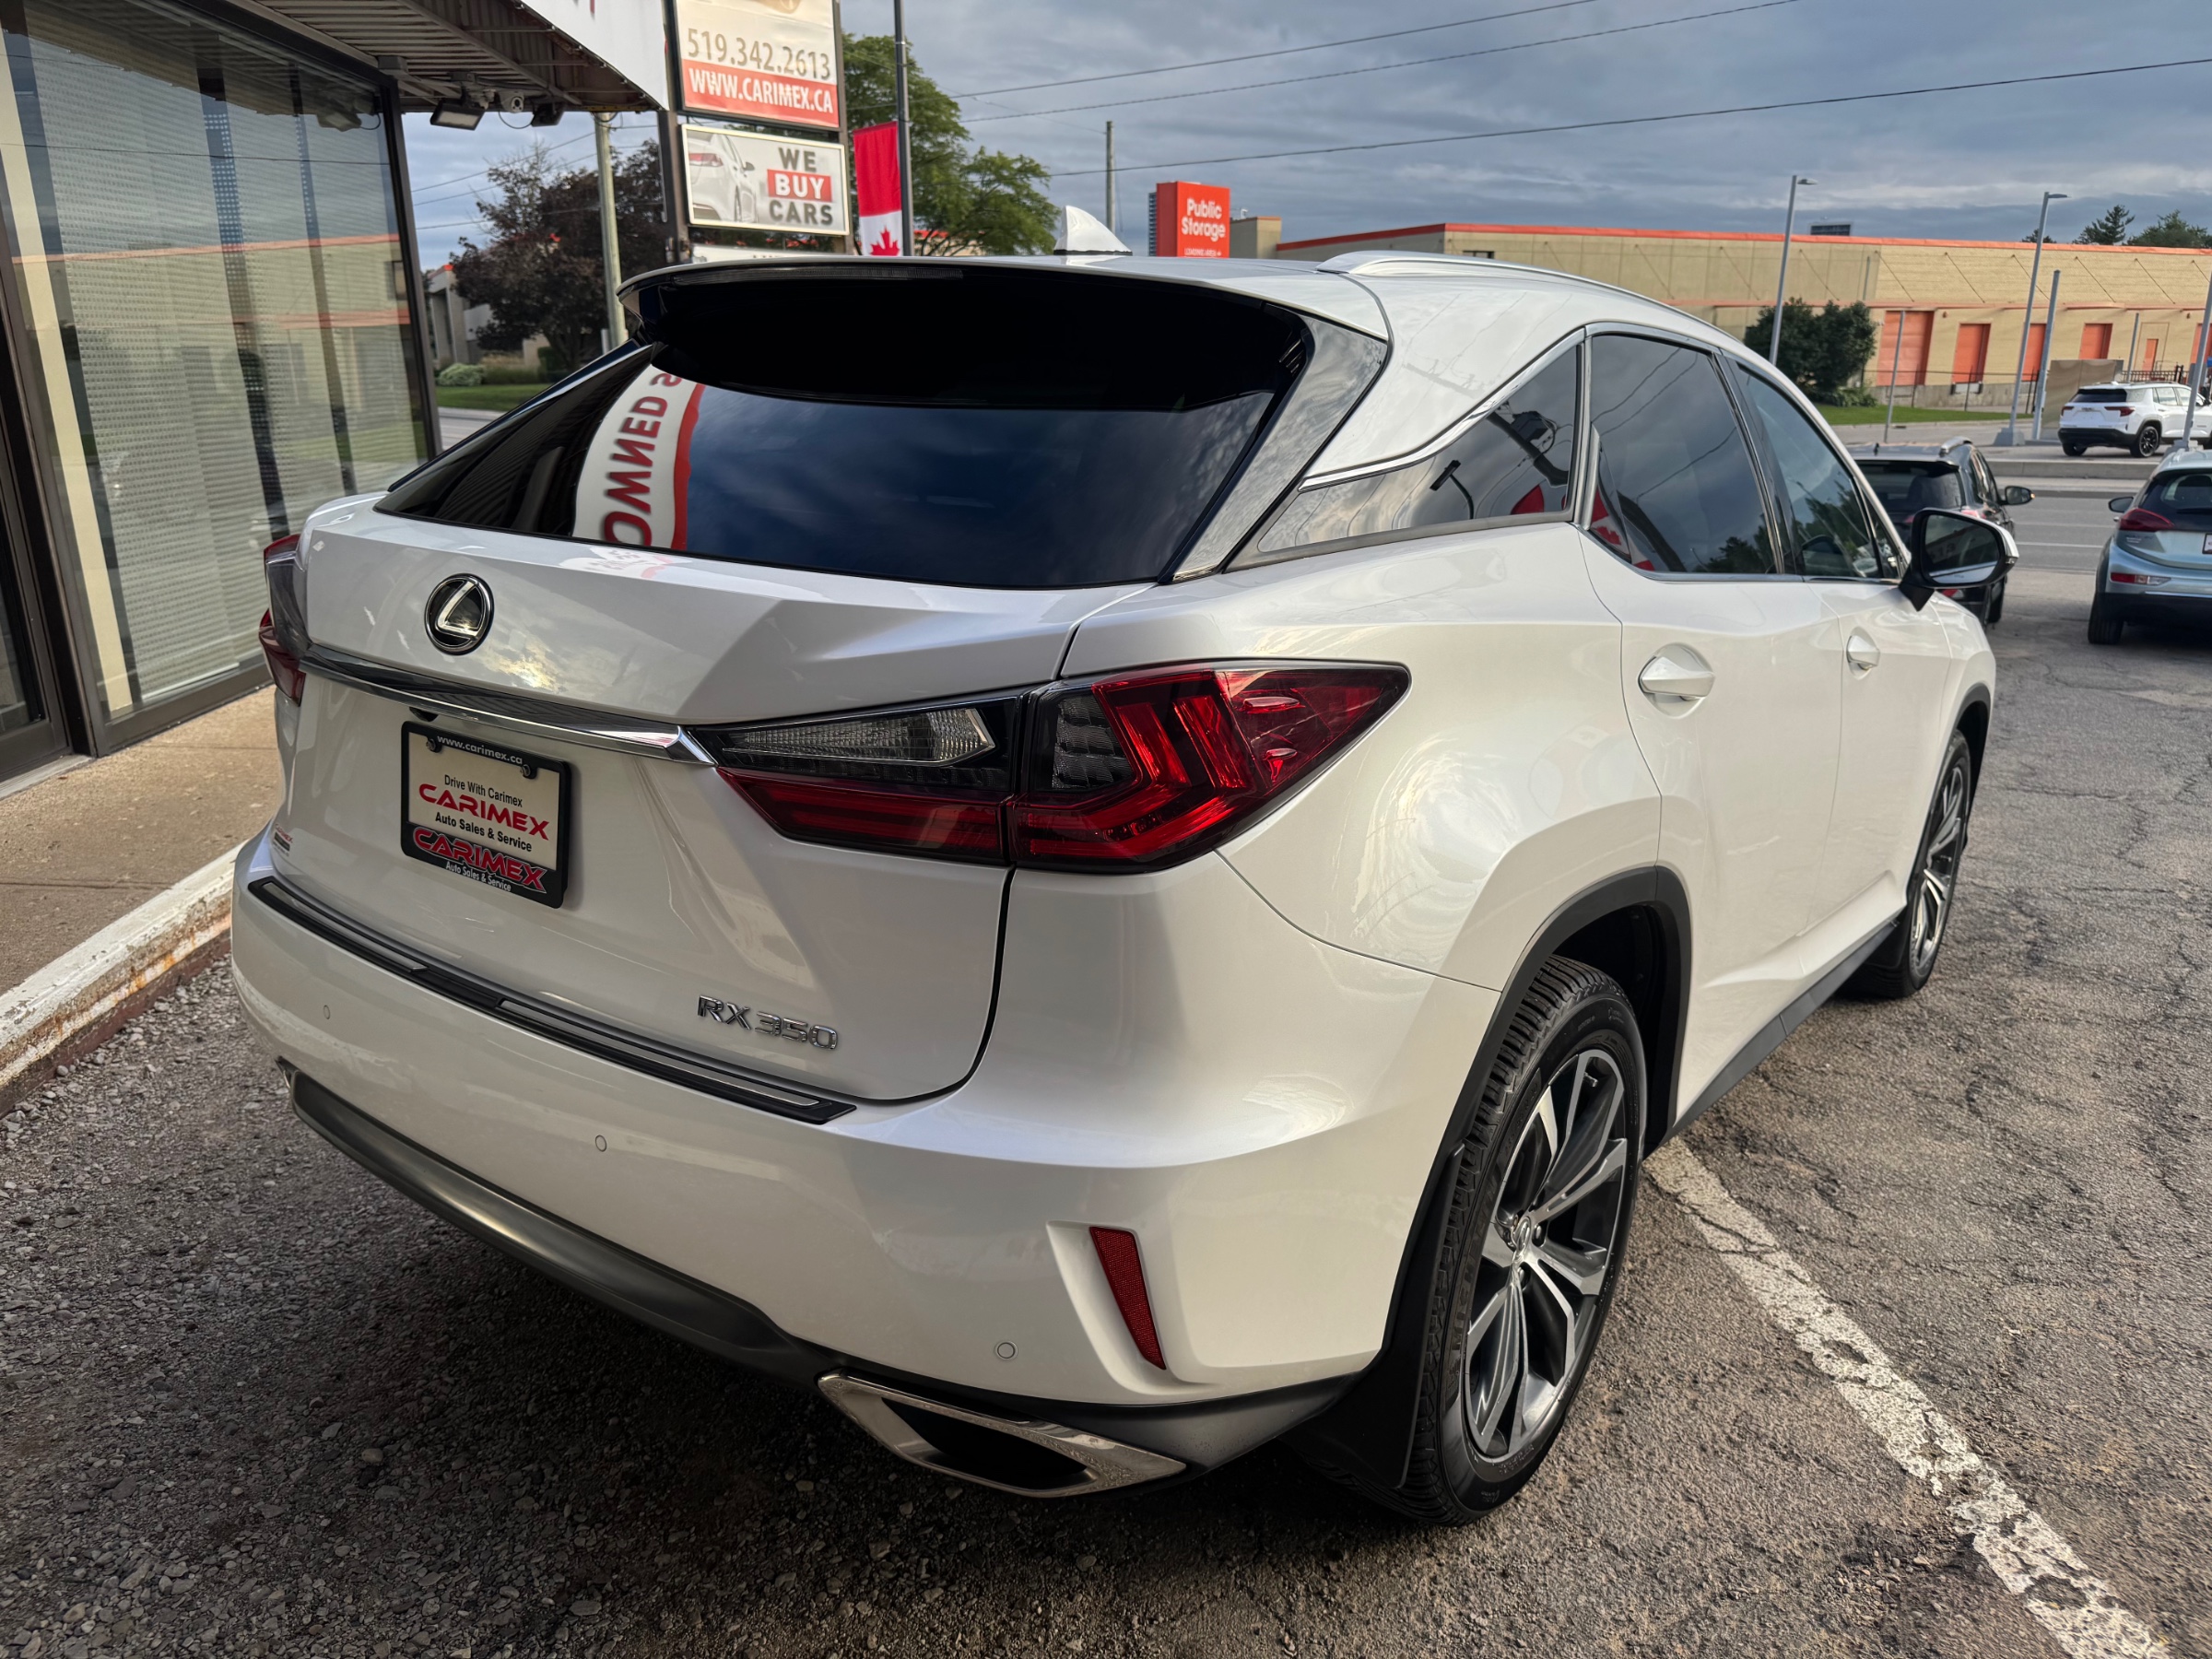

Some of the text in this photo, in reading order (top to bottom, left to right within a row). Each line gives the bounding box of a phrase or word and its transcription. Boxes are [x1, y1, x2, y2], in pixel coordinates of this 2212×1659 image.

[688, 28, 831, 81] 519.342.2613
[688, 67, 834, 114] WWW.CARIMEX.CA
[779, 147, 817, 172] WE
[773, 172, 825, 199] BUY
[769, 199, 834, 226] CARS
[1187, 198, 1222, 219] Public
[1182, 217, 1226, 241] Storage
[437, 735, 523, 765] www.carimex.ca
[444, 774, 523, 807] Drive With Carimex
[418, 783, 549, 841] CARIMEX
[435, 811, 532, 853] Auto Sales & Service
[414, 827, 547, 893] CARIMEX
[445, 861, 512, 892] Auto Sales & Service
[697, 994, 839, 1050] RX 350
